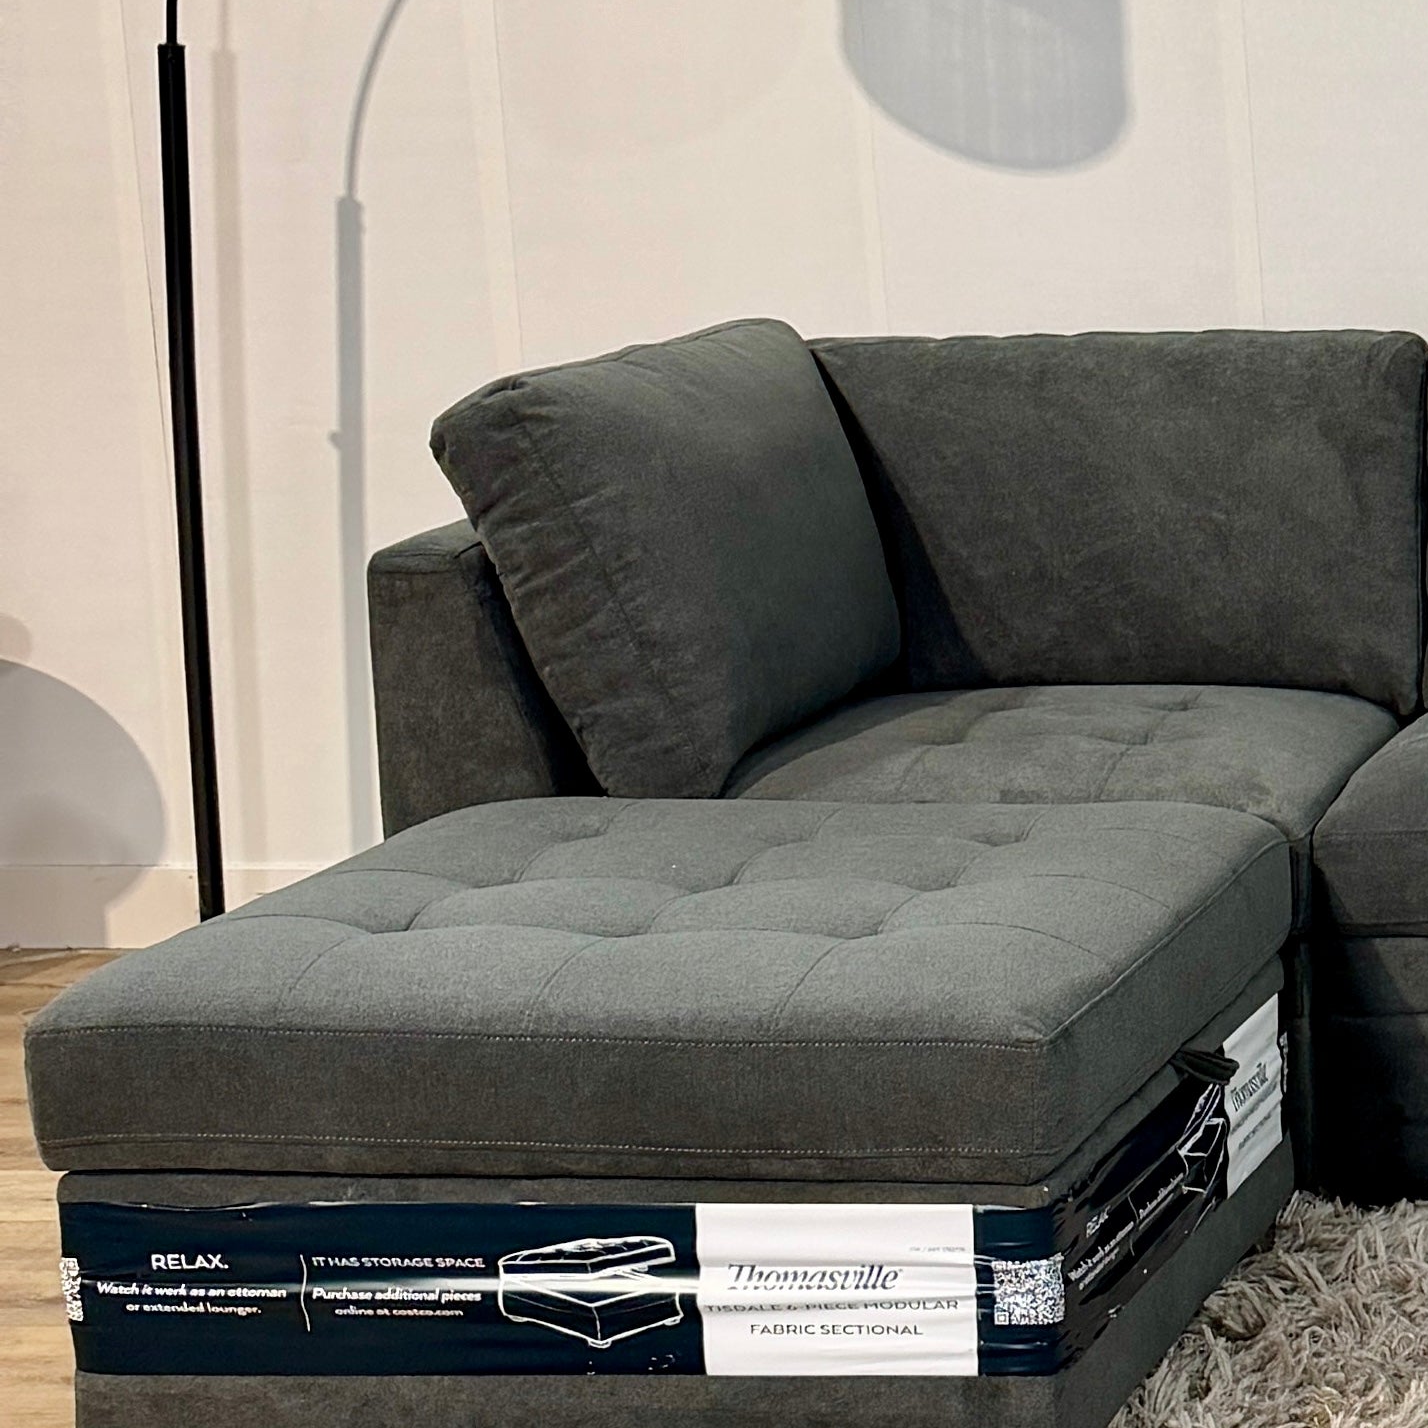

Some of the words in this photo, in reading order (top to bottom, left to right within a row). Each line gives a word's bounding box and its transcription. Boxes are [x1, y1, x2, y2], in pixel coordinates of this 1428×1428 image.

[150, 1253, 229, 1270] RELAX.
[311, 1256, 326, 1266] IT
[327, 1256, 361, 1267] HAS
[361, 1257, 434, 1268] STORAGE
[435, 1257, 486, 1268] SPACE
[96, 1280, 140, 1296] Watch
[141, 1283, 153, 1296] it
[190, 1287, 206, 1298] as
[208, 1287, 225, 1298] an
[226, 1286, 287, 1298] ottoman
[312, 1286, 373, 1301] Purchase
[374, 1286, 439, 1302] additional
[440, 1290, 482, 1304] pieces
[125, 1302, 140, 1312] or
[142, 1302, 205, 1313] extended
[206, 1302, 262, 1316] lounger.
[864, 1299, 959, 1311] MODULAR
[750, 1324, 816, 1335] FABRIC
[820, 1324, 923, 1335] SECTIONAL
